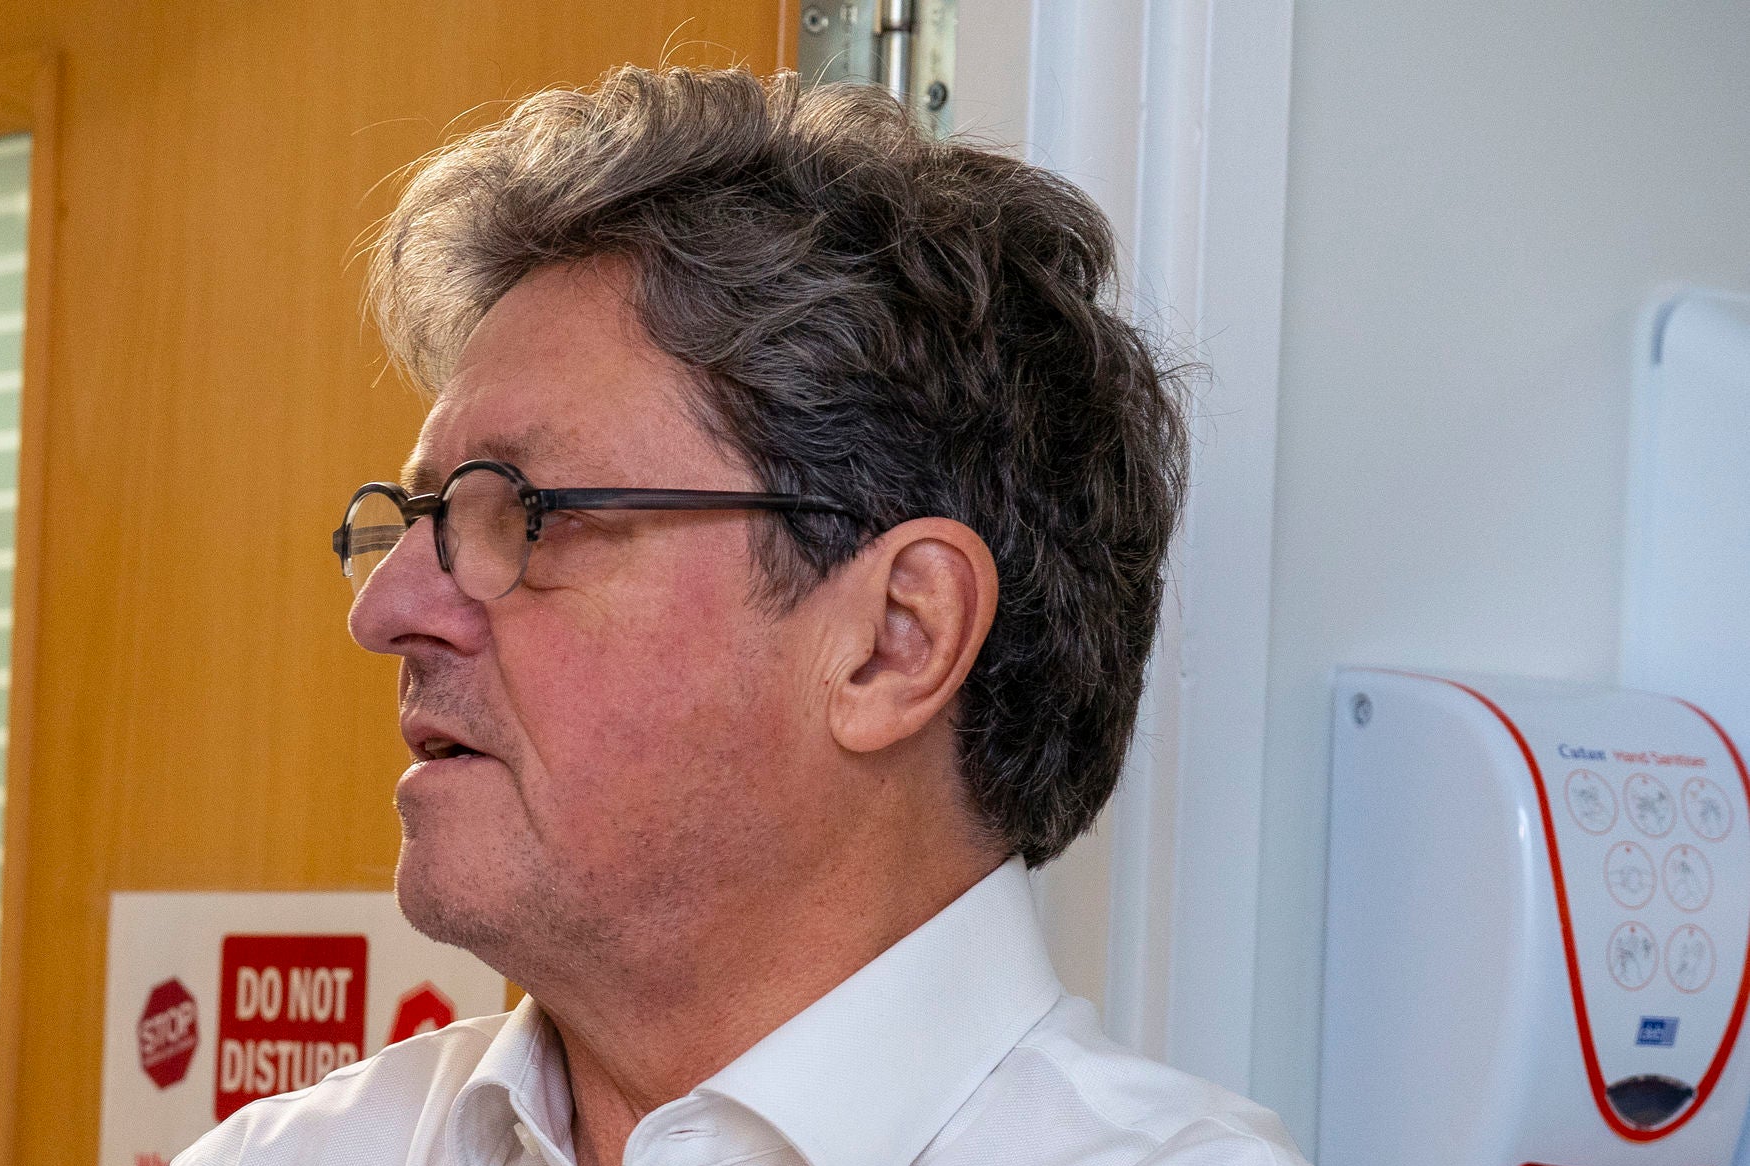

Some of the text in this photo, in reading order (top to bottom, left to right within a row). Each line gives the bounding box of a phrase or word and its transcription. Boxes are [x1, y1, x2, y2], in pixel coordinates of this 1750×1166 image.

[235, 966, 354, 1022] DO NOT
[139, 1001, 195, 1054] STOP
